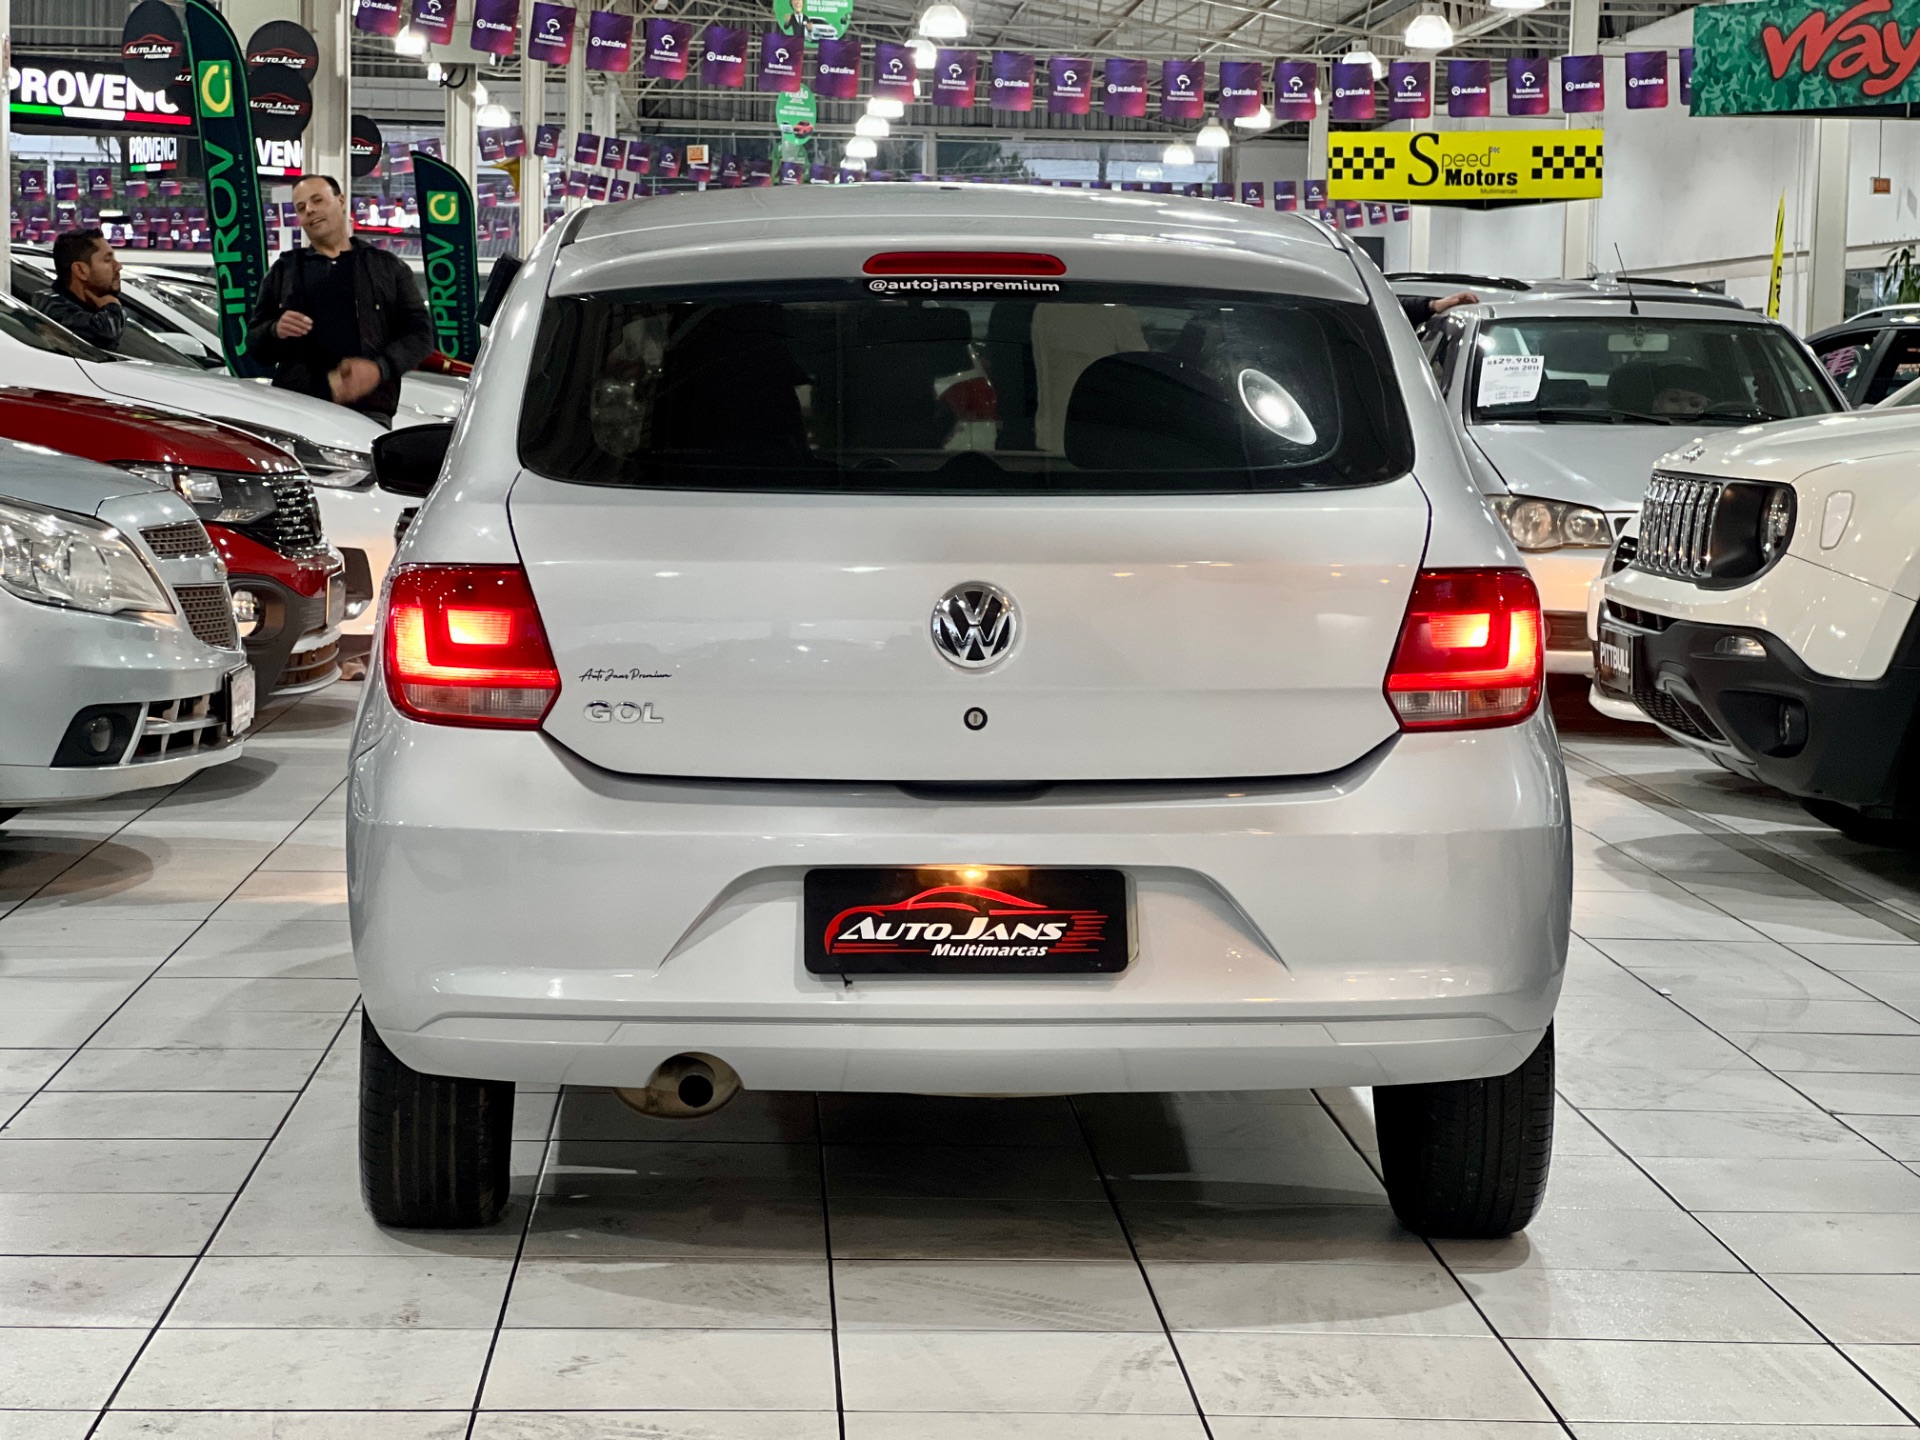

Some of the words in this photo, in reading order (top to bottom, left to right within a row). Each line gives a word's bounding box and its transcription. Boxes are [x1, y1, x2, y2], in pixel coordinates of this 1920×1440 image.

[1762, 0, 1920, 96] Way
[129, 136, 177, 164] PROVENCI
[1407, 132, 1491, 187] Speed
[1444, 168, 1518, 187] Motors
[426, 233, 460, 359] CIPROV
[868, 278, 1060, 293] @autojanspremium
[583, 699, 664, 724] GOL
[930, 943, 1049, 958] Multimarcas
